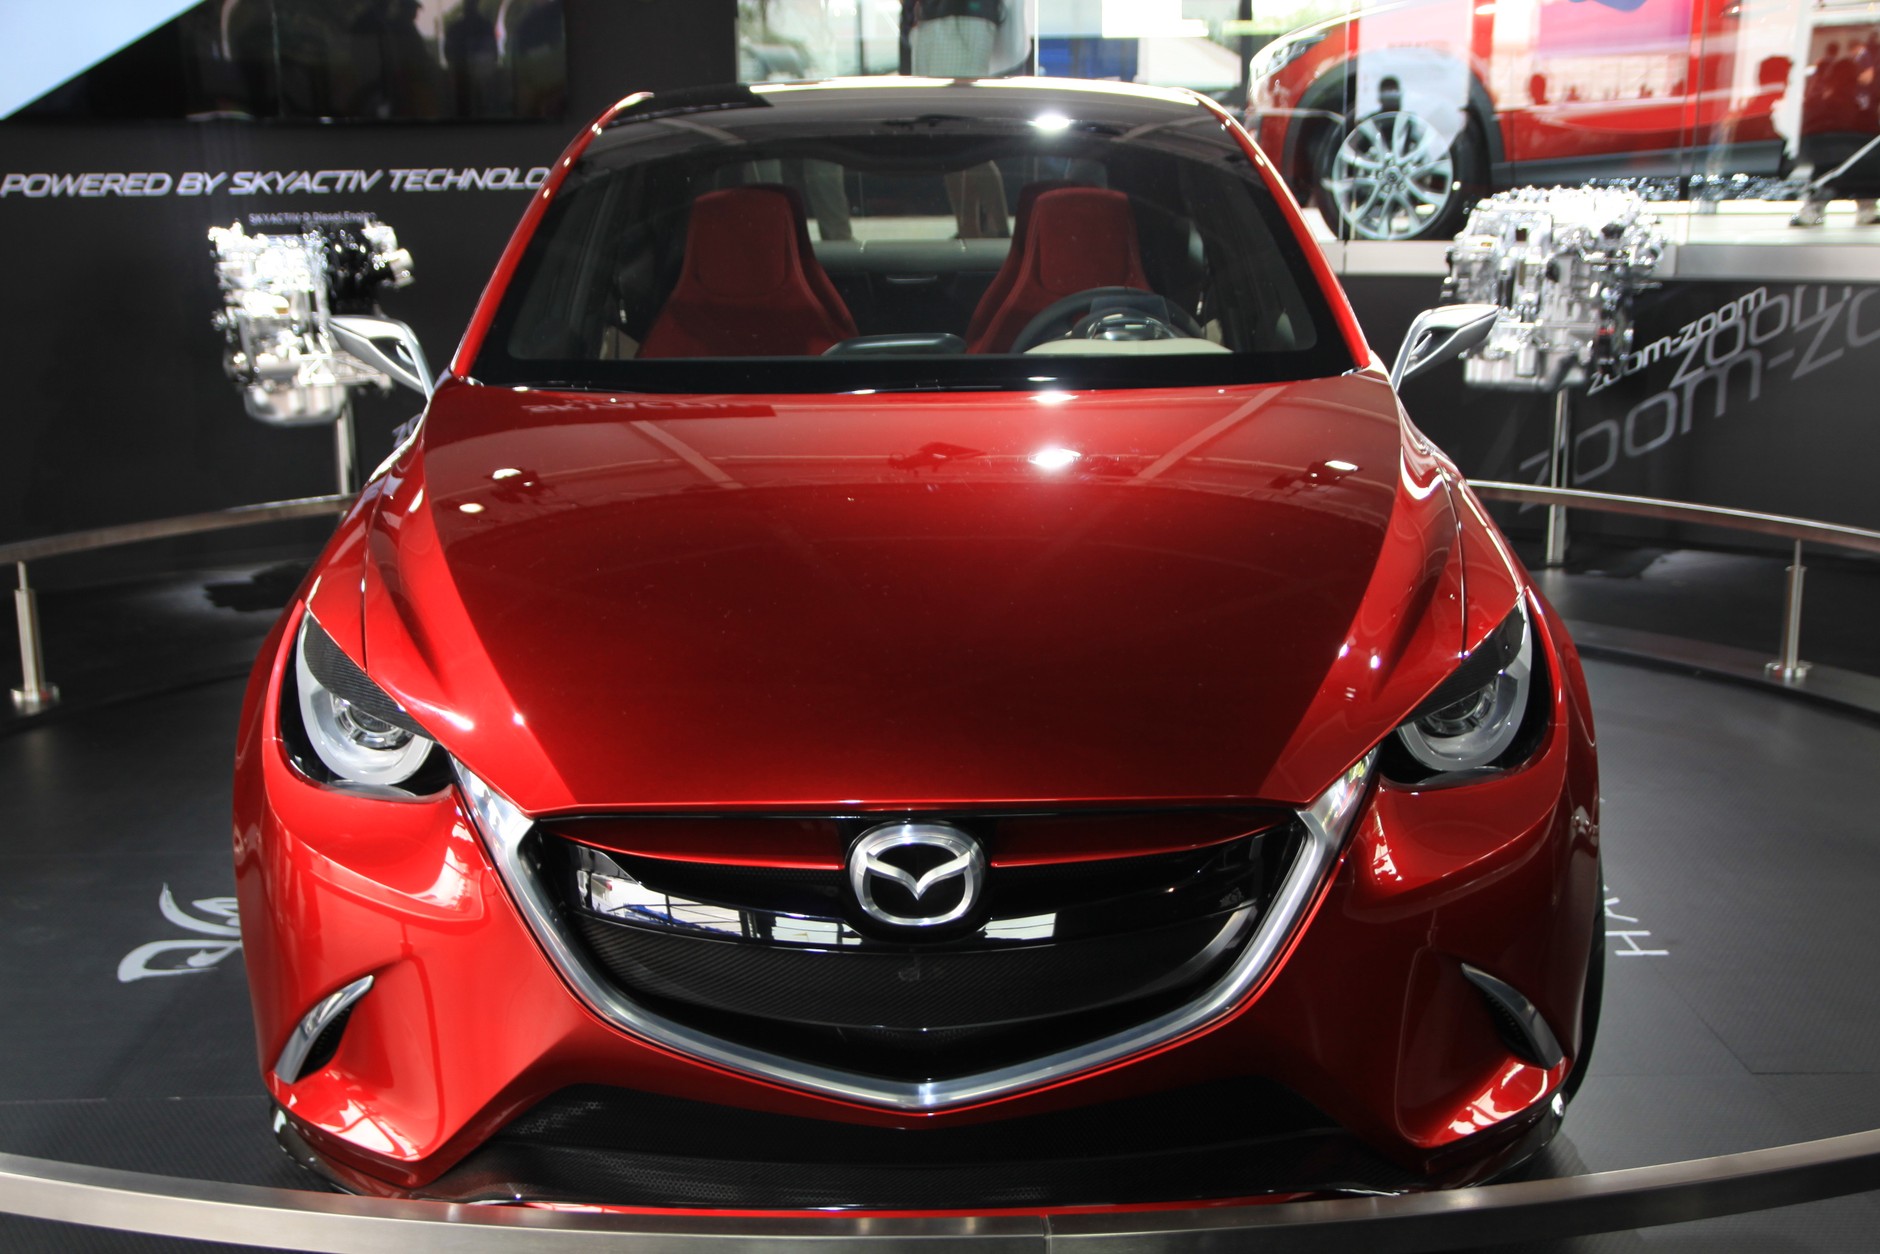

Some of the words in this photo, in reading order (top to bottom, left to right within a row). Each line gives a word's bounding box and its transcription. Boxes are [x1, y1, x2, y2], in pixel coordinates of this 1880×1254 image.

[0, 173, 174, 198] POWERED
[176, 171, 229, 196] BY
[228, 169, 384, 196] SKYACTIV
